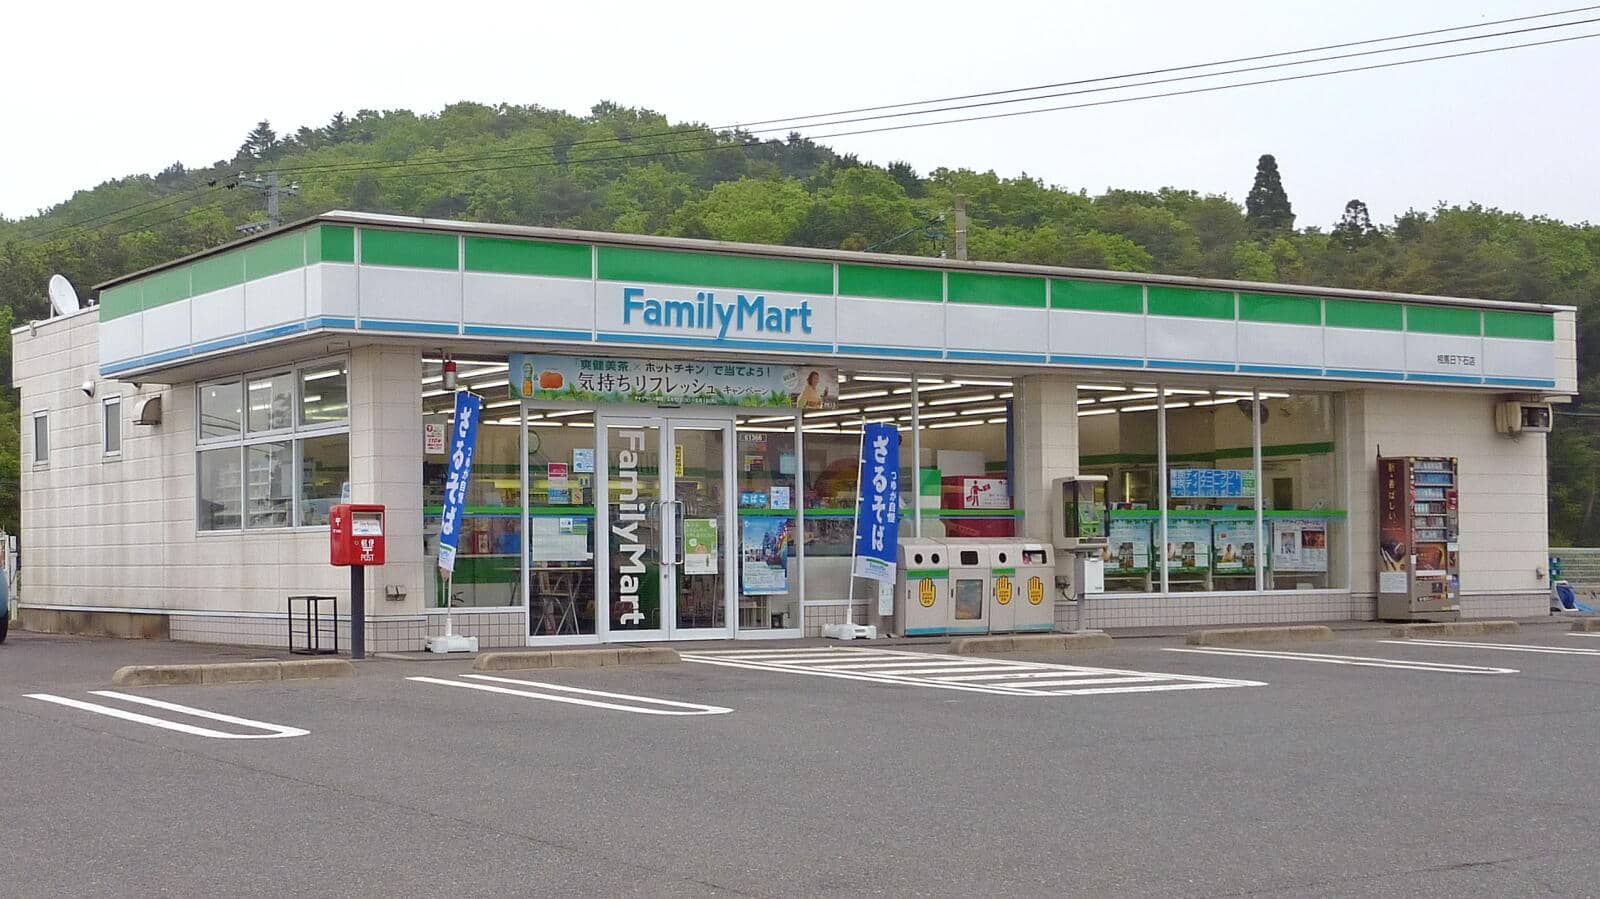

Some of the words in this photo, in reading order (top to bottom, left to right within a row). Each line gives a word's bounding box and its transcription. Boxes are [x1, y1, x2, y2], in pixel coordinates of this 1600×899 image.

[623, 287, 812, 340] FamilyMart
[579, 372, 716, 395] 気持ちリフレッシュ
[612, 430, 647, 625] FamilyMart
